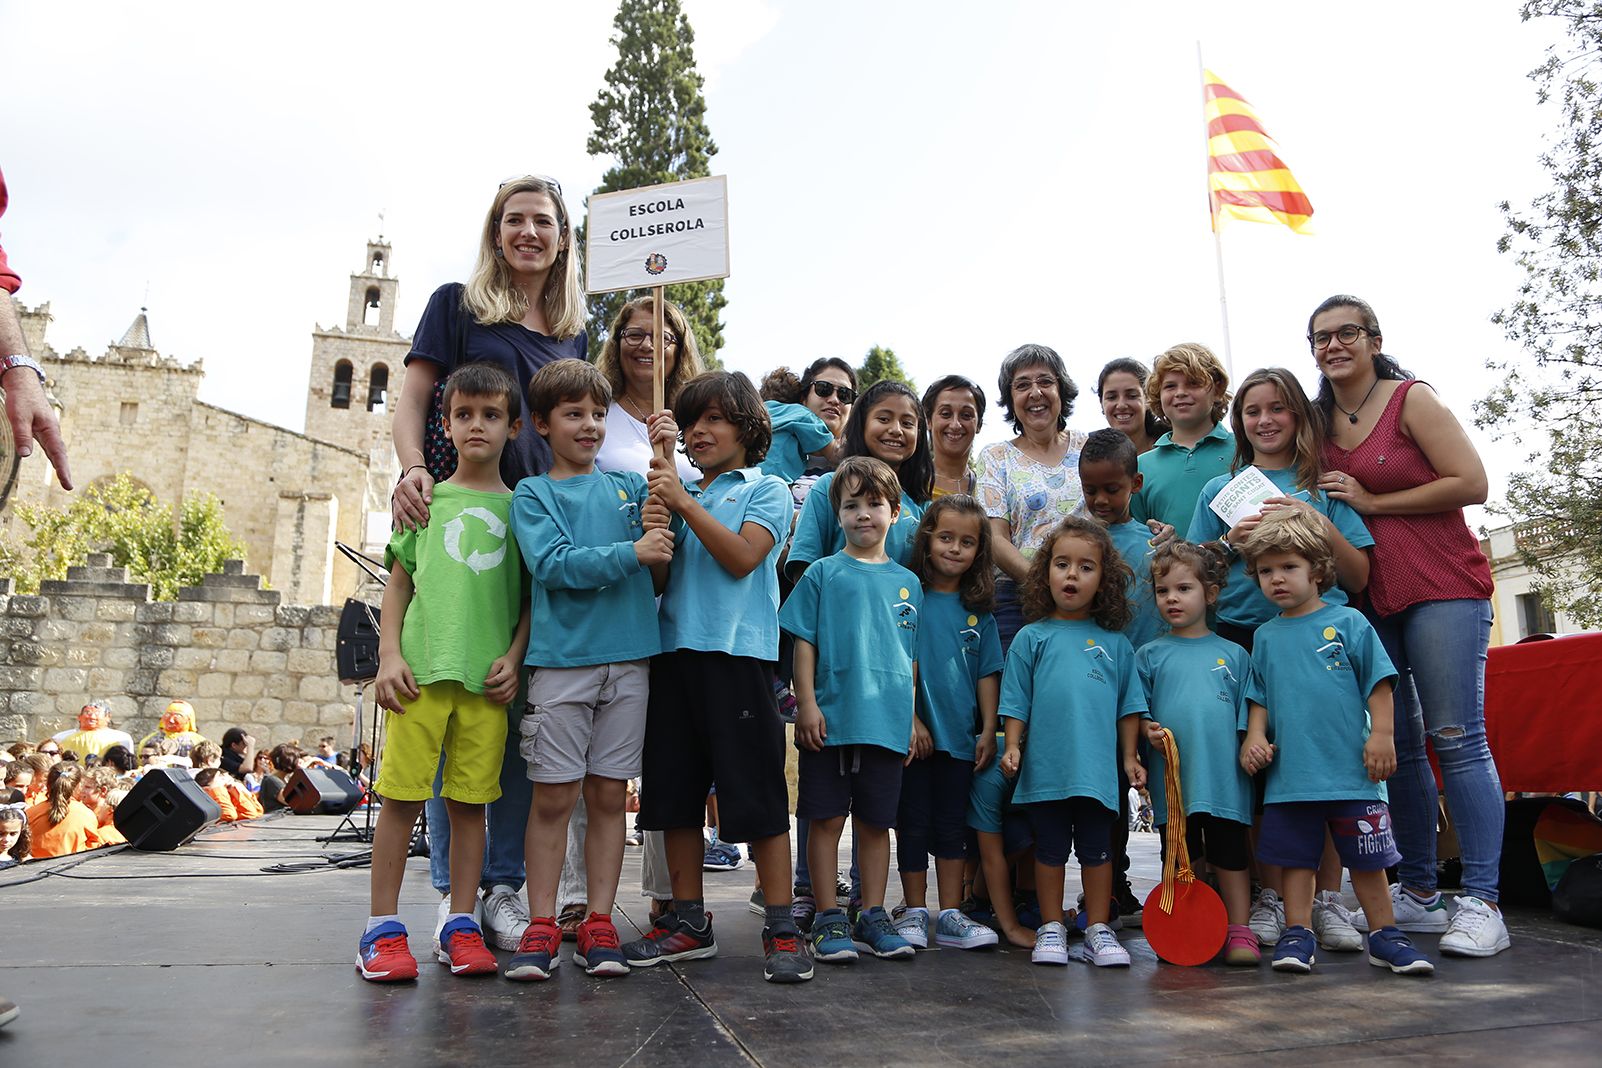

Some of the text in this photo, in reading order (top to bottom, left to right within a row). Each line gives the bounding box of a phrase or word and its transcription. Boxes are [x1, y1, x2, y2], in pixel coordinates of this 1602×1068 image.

[629, 198, 685, 217] ESCOLA
[610, 218, 705, 242] COLLSEROLA
[1220, 475, 1262, 513] GEGANTS
[1226, 508, 1233, 518] DE
